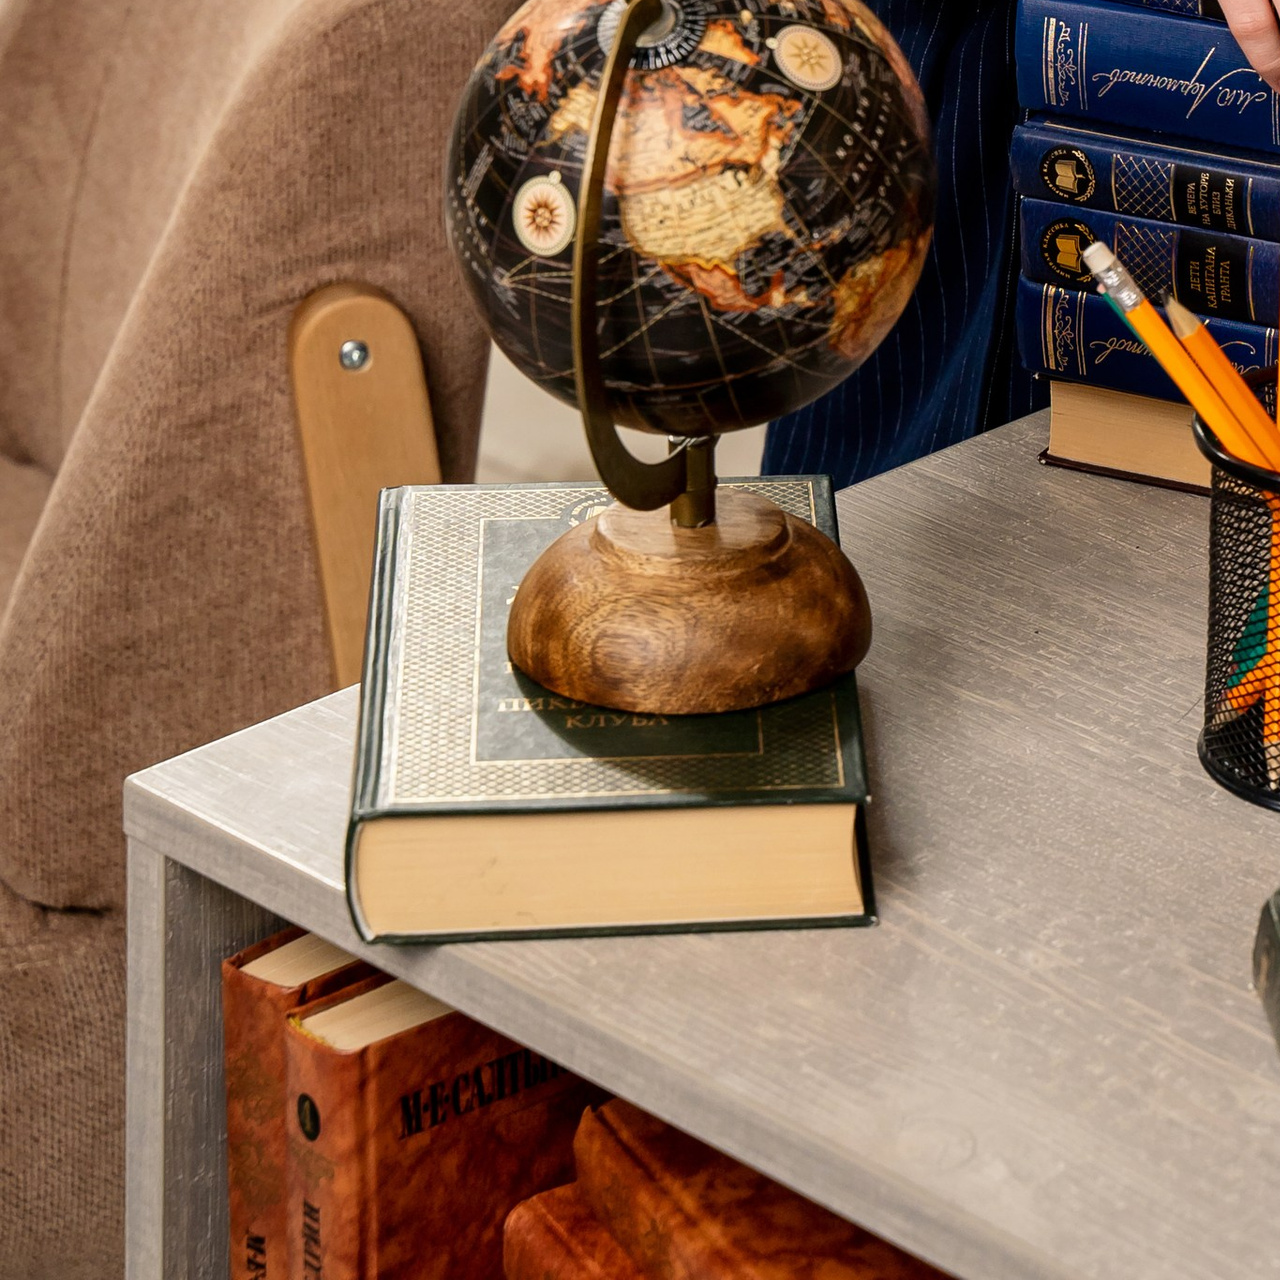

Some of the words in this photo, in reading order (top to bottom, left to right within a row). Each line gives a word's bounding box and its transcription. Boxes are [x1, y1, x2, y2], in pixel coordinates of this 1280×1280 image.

[1187, 181, 1198, 216] ВЕЧЕРА
[1199, 172, 1210, 212] ХУТОРЕ
[1212, 191, 1222, 216] БЛИЗ
[1224, 178, 1237, 231] ДИКАНЬКИ
[1202, 212, 1212, 226] НА
[1189, 259, 1202, 293] ДЕТИ
[1204, 246, 1218, 310] КАПИТАНА
[1219, 260, 1232, 303] ГРАНТА
